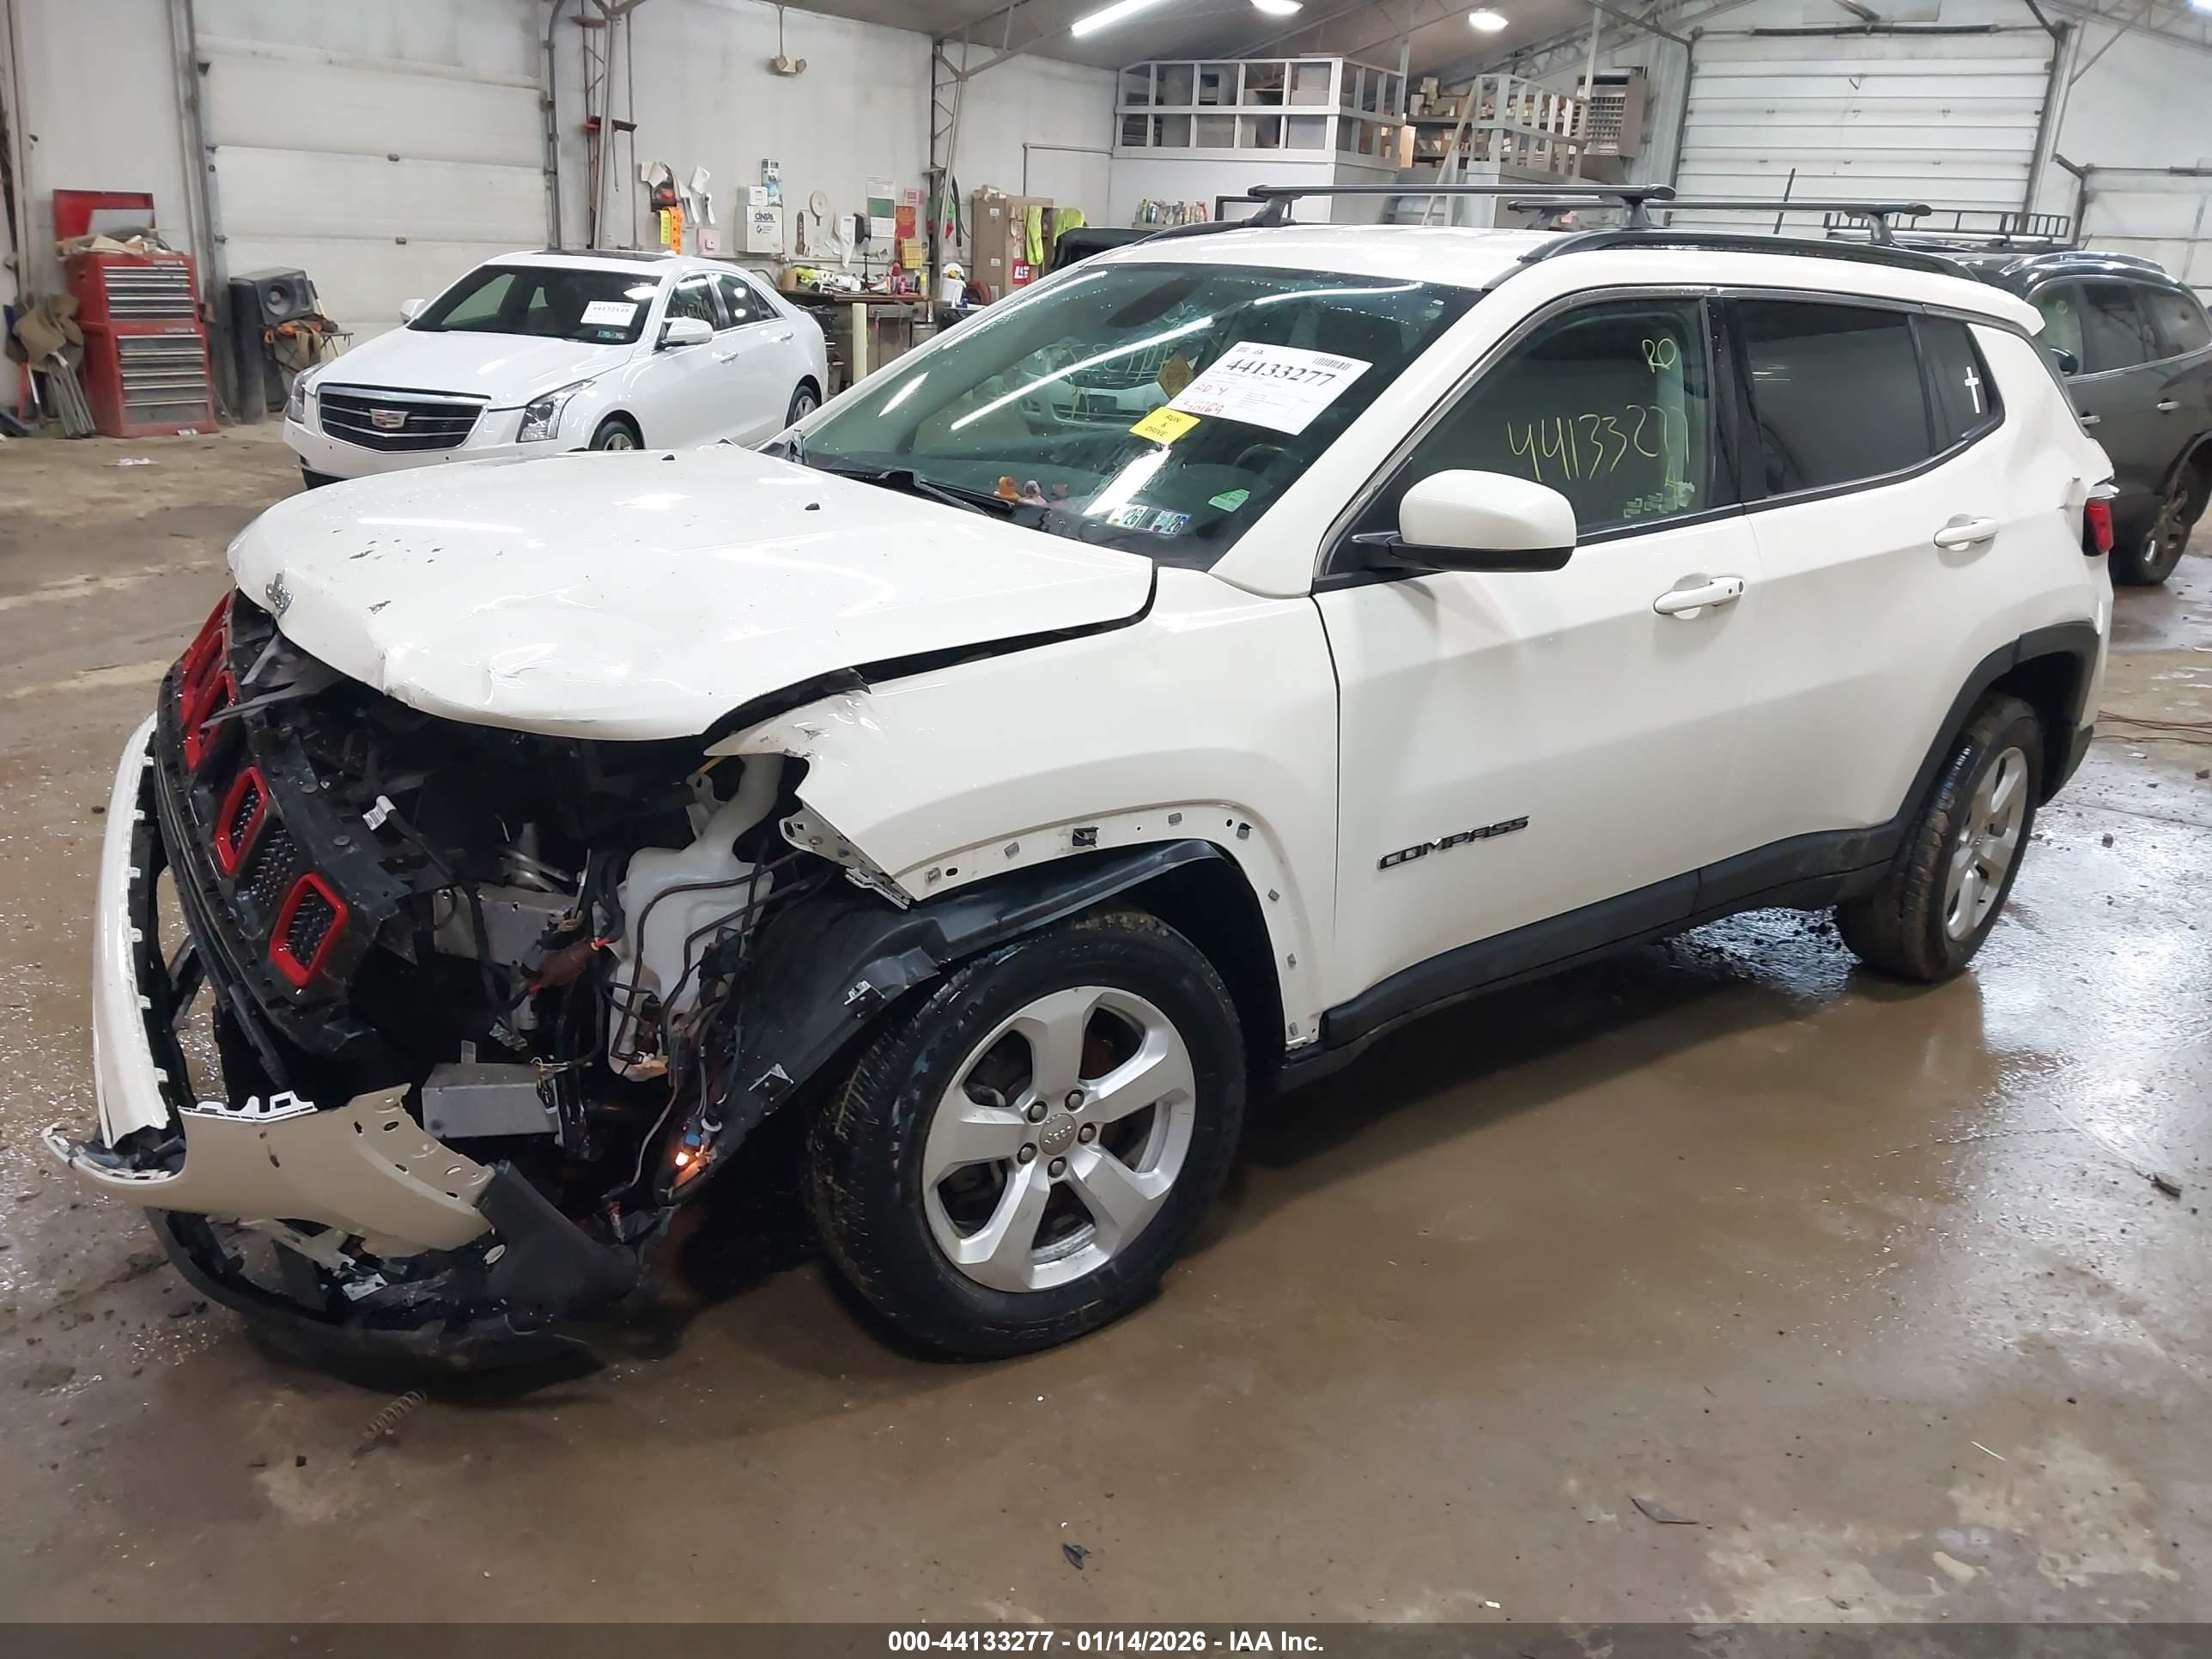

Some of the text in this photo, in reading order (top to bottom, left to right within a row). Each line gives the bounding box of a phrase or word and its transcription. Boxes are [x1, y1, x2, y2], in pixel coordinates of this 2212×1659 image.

[1226, 358, 1336, 386] 44133277
[1164, 414, 1182, 423] RUN
[1145, 425, 1168, 437] DRIVE
[1377, 815, 1529, 871] COMPASS
